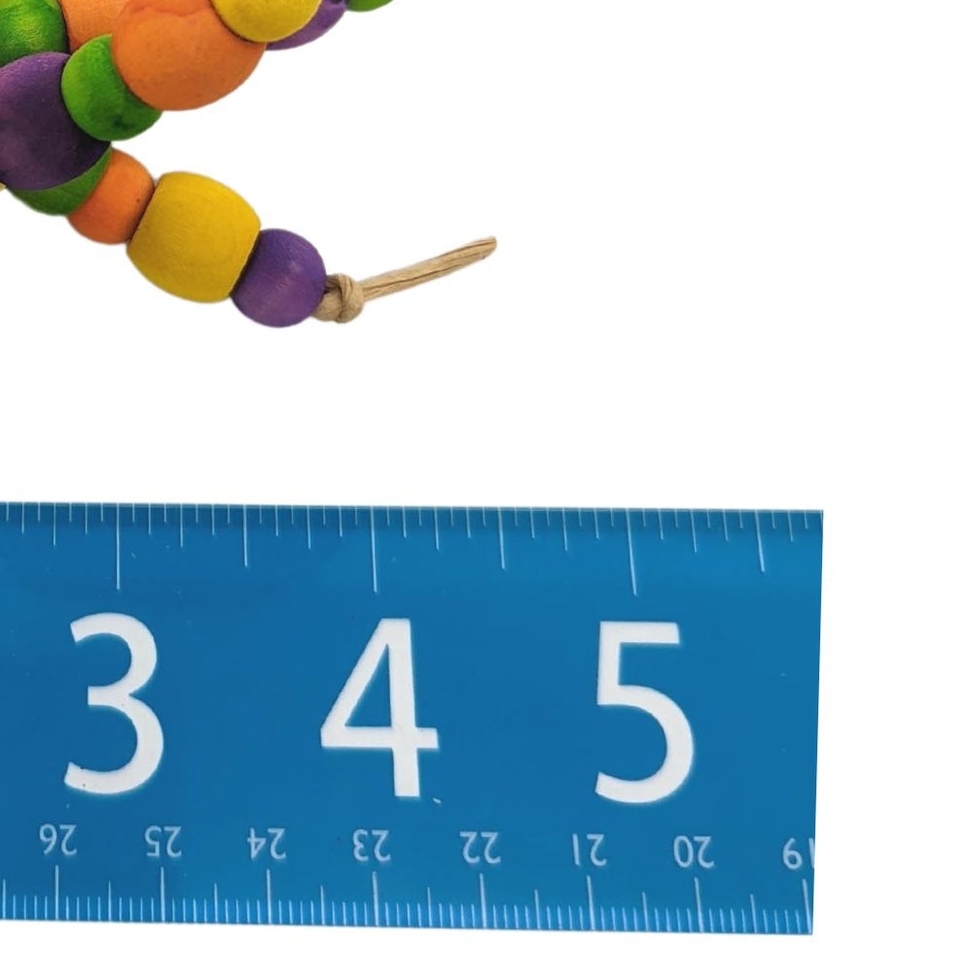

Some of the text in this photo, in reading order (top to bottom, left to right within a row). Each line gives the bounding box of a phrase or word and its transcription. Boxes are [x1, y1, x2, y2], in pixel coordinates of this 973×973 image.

[64, 611, 164, 795] 3
[320, 617, 439, 798] 4
[595, 620, 695, 804] 5
[38, 823, 78, 855] 26
[143, 825, 183, 858] 25
[246, 828, 287, 860] 24
[352, 830, 392, 862] 23
[459, 831, 502, 864] 22
[572, 833, 608, 866] 21
[673, 835, 715, 868] 20
